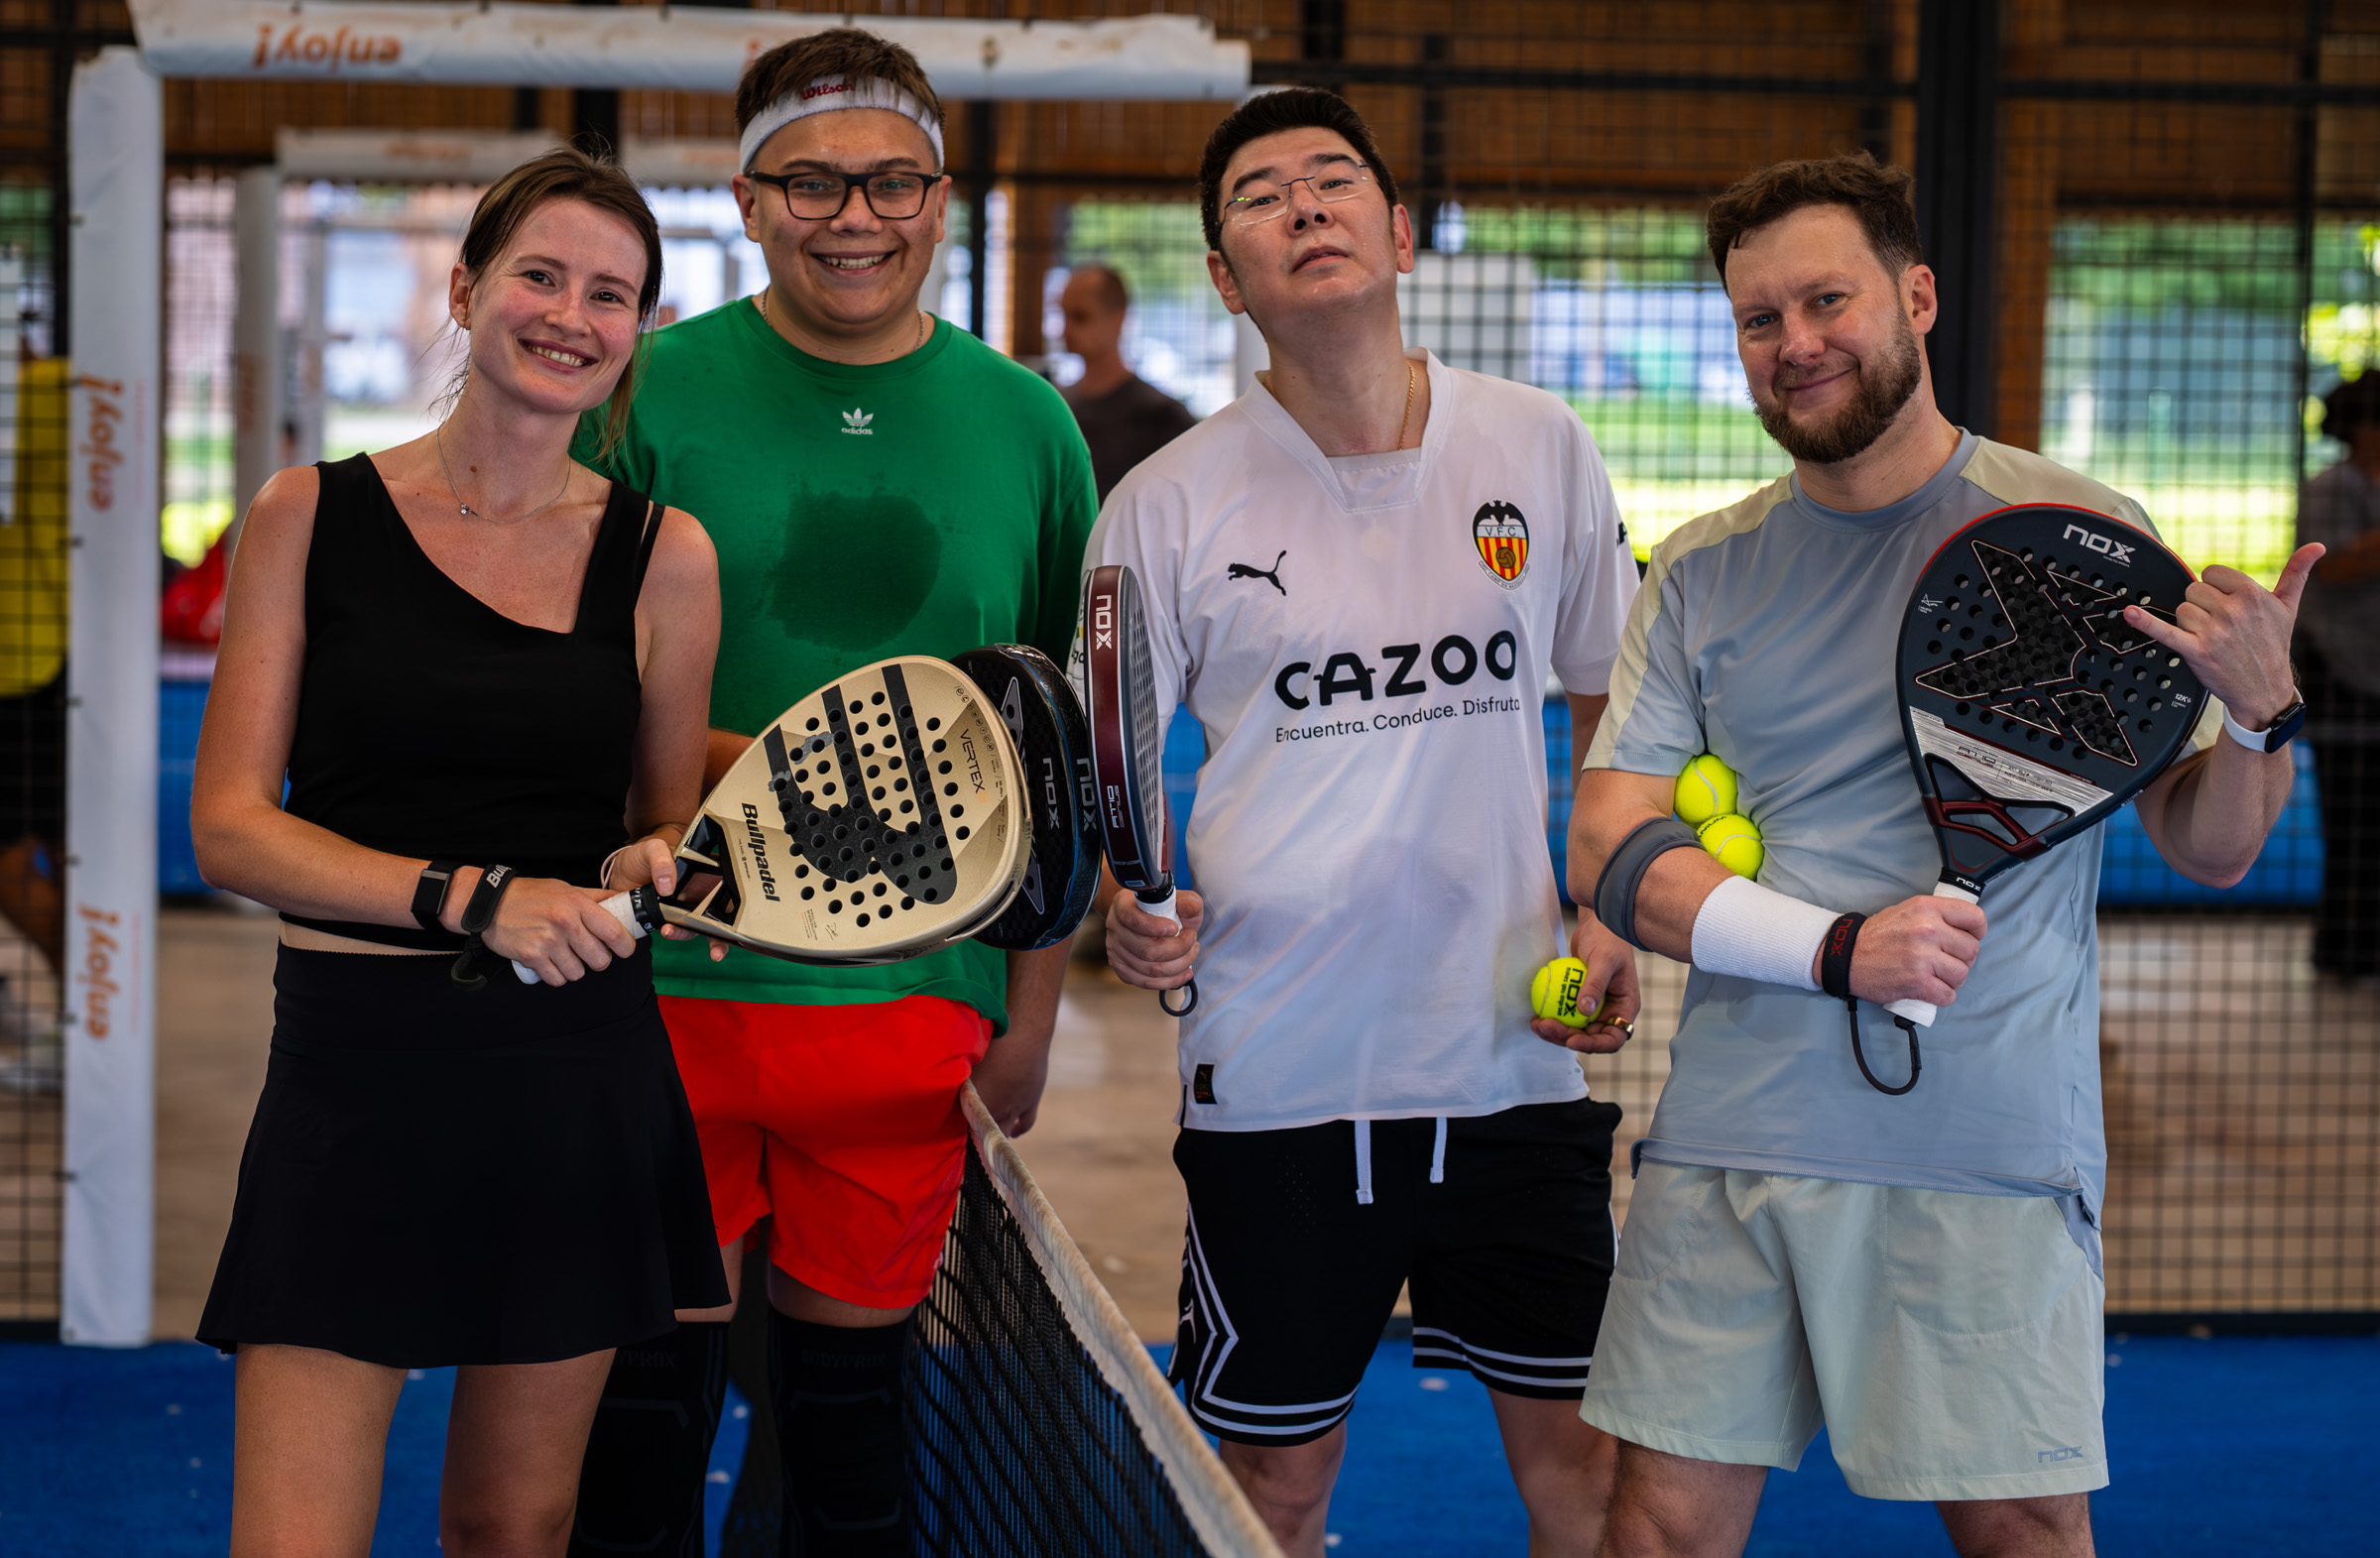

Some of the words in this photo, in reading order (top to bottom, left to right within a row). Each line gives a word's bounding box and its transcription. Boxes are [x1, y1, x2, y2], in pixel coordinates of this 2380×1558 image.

[250, 22, 403, 74] enjoy!
[802, 83, 855, 101] Wilson
[78, 373, 125, 514] enjoy!
[841, 426, 873, 435] adidas
[1274, 630, 1516, 710] CAZOO
[1276, 720, 1369, 742] Encuentra.
[1373, 705, 1458, 730] Conduce.
[960, 728, 986, 793] VERTEX
[741, 802, 780, 902] Bullpadel
[76, 902, 120, 1041] enjoy!
